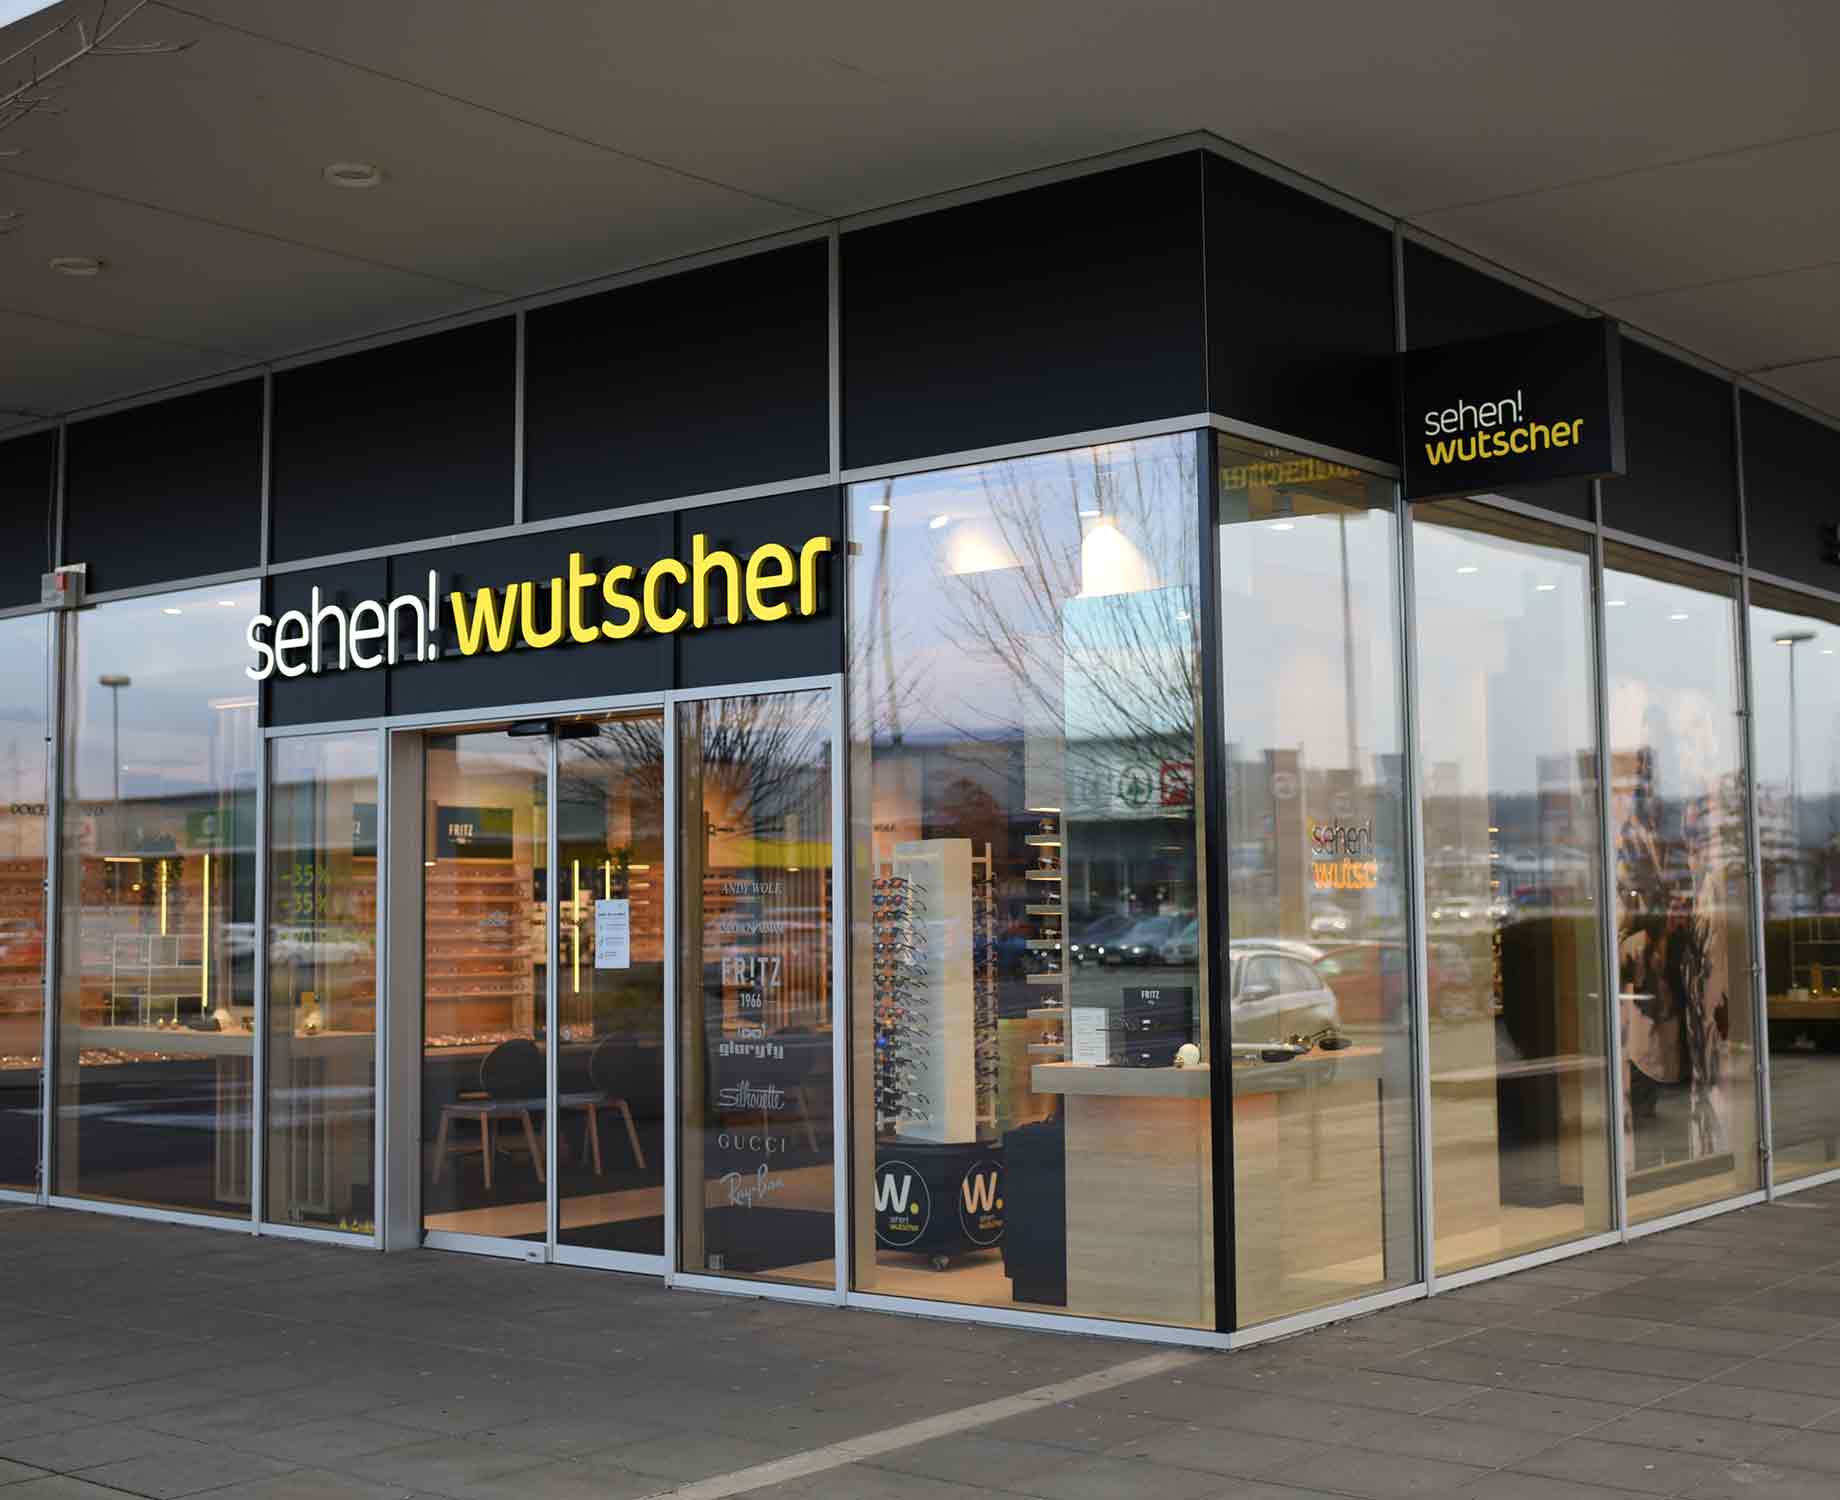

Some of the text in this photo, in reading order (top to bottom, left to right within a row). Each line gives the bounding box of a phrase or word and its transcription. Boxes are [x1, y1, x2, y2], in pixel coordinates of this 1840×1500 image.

[1424, 389, 1524, 436] sehen!
[1424, 418, 1584, 467] wutscher
[245, 533, 832, 681] sehen! wutscher
[740, 993, 762, 1008] 1966
[717, 1133, 786, 1153] GUCCI
